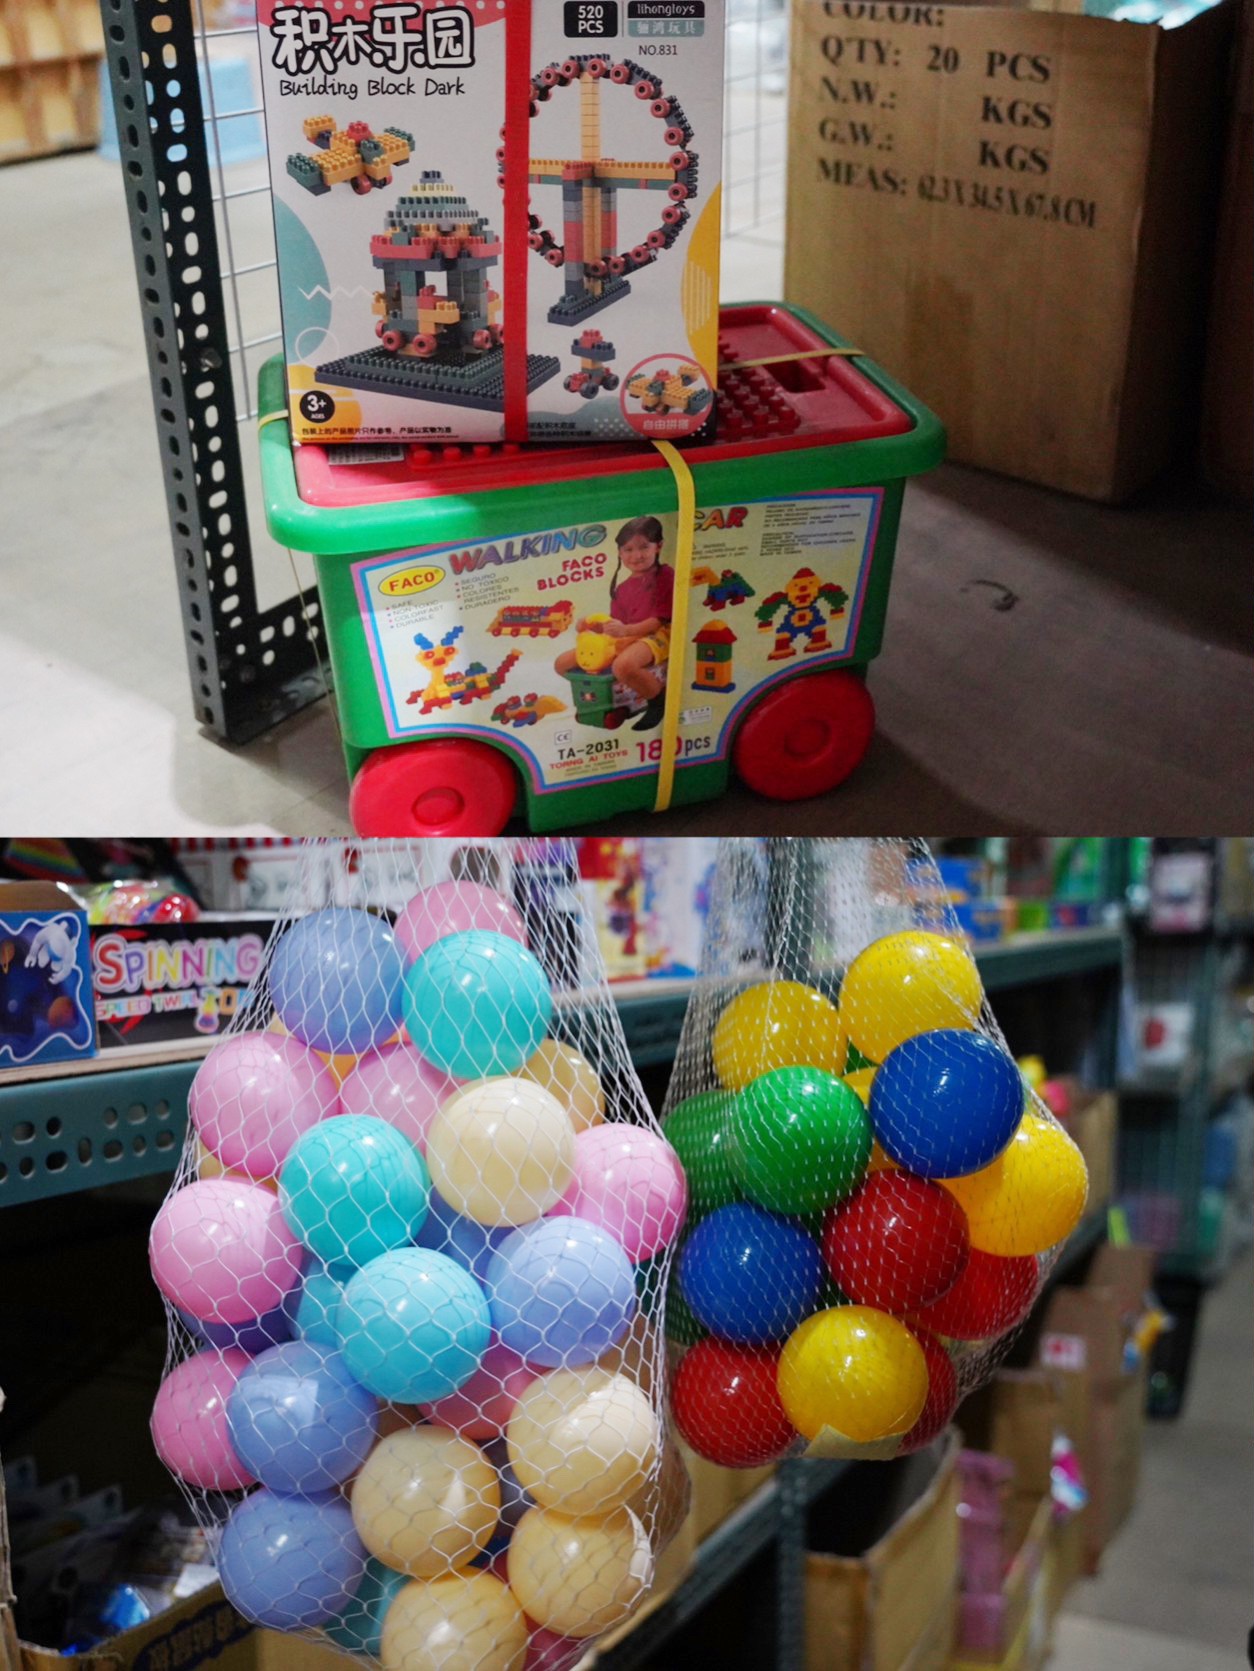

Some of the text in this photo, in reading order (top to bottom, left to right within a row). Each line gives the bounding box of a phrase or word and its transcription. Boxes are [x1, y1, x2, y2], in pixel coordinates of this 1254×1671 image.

[578, 5, 604, 19] 520
[637, 4, 695, 16] lihongtoys
[578, 20, 604, 34] PCS
[270, 3, 476, 76] 积木乐园
[638, 45, 678, 56] NO.831
[927, 45, 961, 74] 20
[986, 51, 1051, 84] PCS
[280, 75, 465, 100] Building Block Dark
[980, 96, 1053, 130] KGS
[978, 140, 1050, 175] KGS
[307, 394, 327, 412] 3+
[449, 524, 607, 575] WALKING
[562, 553, 607, 572] FACO
[388, 571, 435, 592] FACO
[537, 566, 605, 591] BLOCKS
[558, 738, 620, 760] TA-2031
[603, 750, 628, 760] TOYS
[685, 735, 711, 756] pcs
[96, 937, 263, 989] SPINNING
